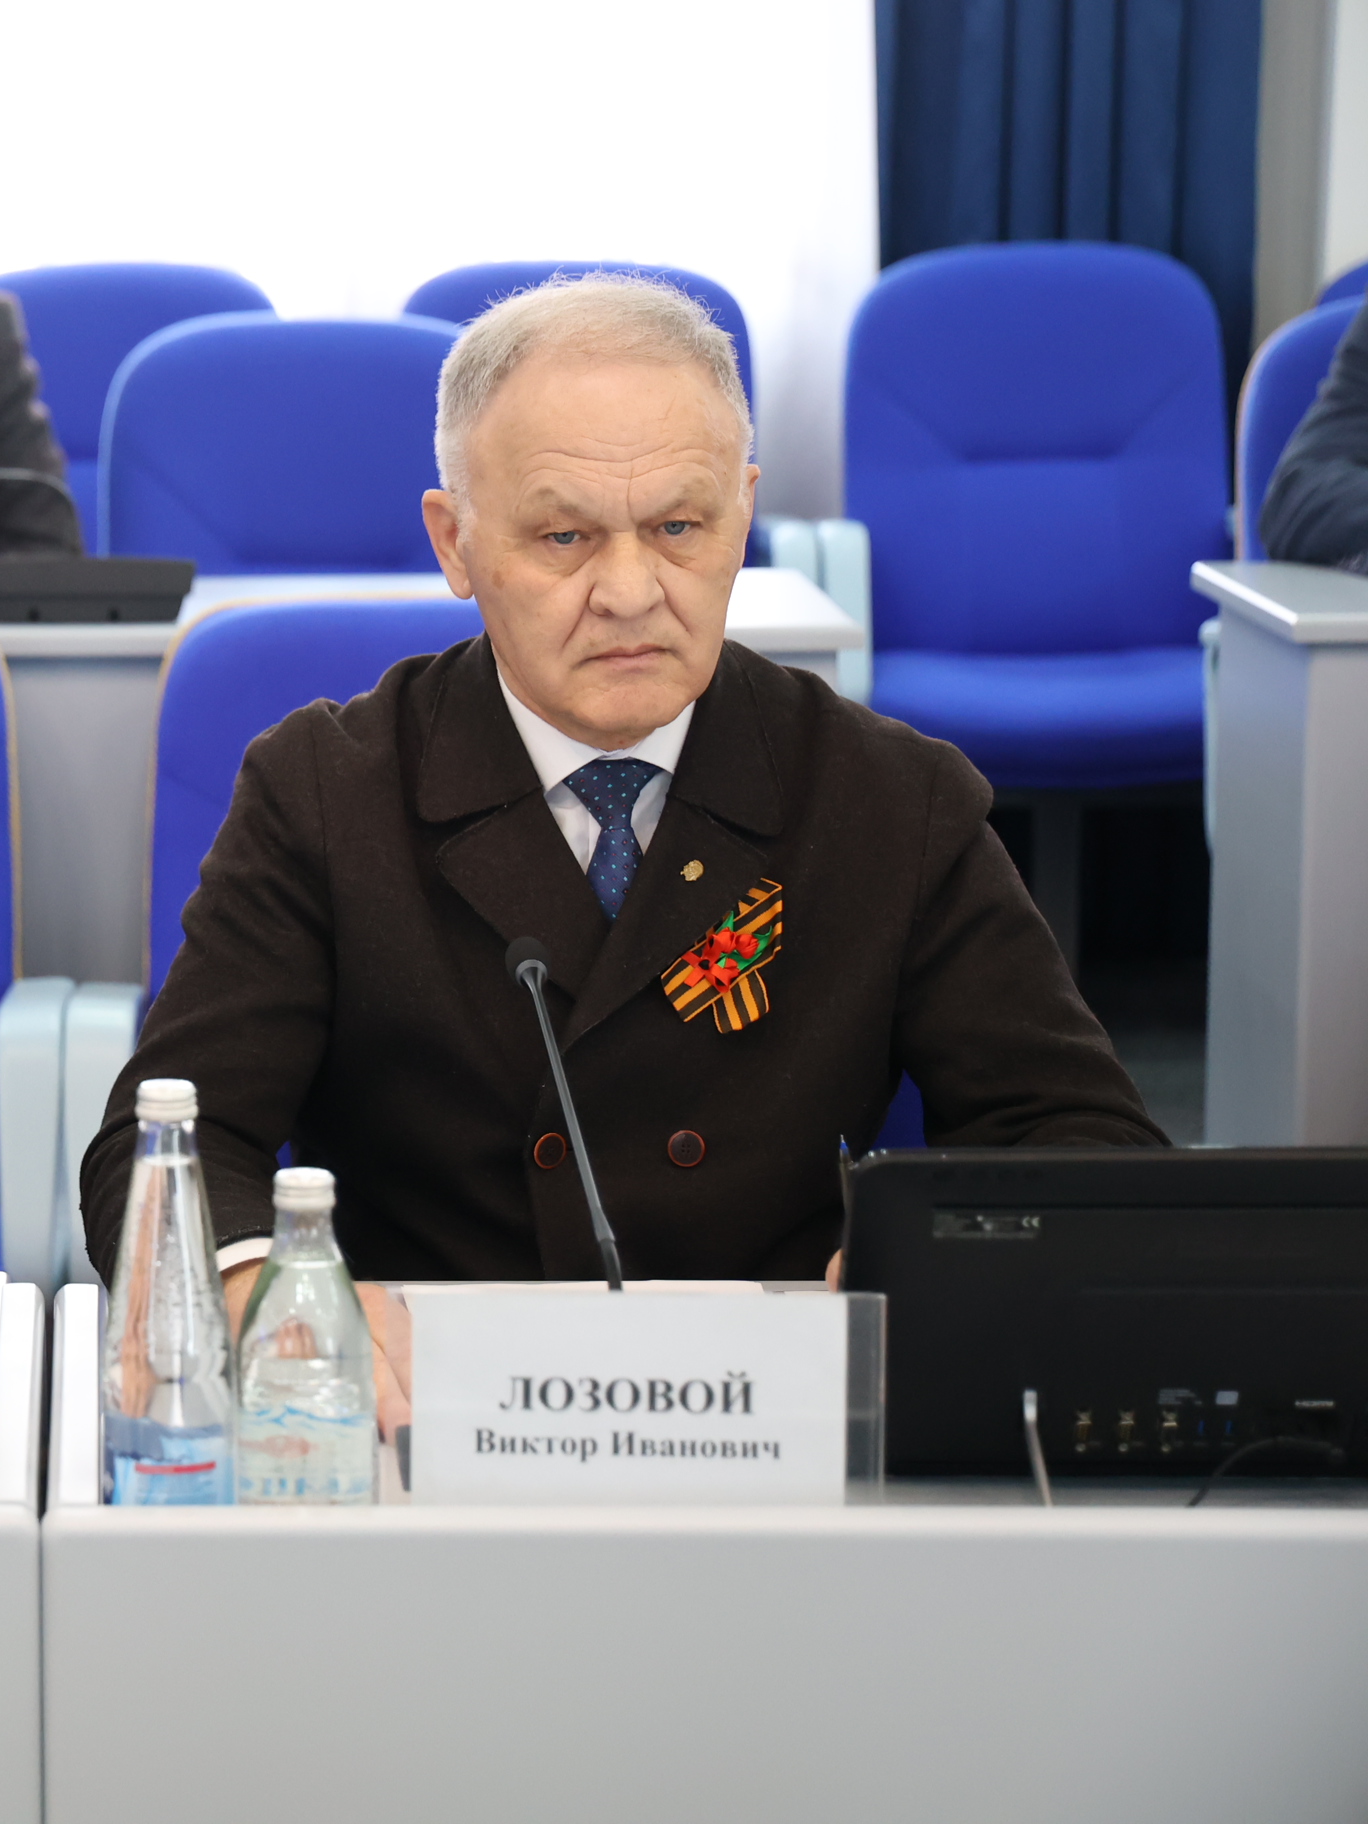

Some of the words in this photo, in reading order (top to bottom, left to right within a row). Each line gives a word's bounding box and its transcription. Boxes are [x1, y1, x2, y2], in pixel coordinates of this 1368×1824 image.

[498, 1370, 755, 1415] ЛОЗОВОЙ
[475, 1427, 599, 1463] Виктор
[611, 1430, 781, 1460] Иванович
